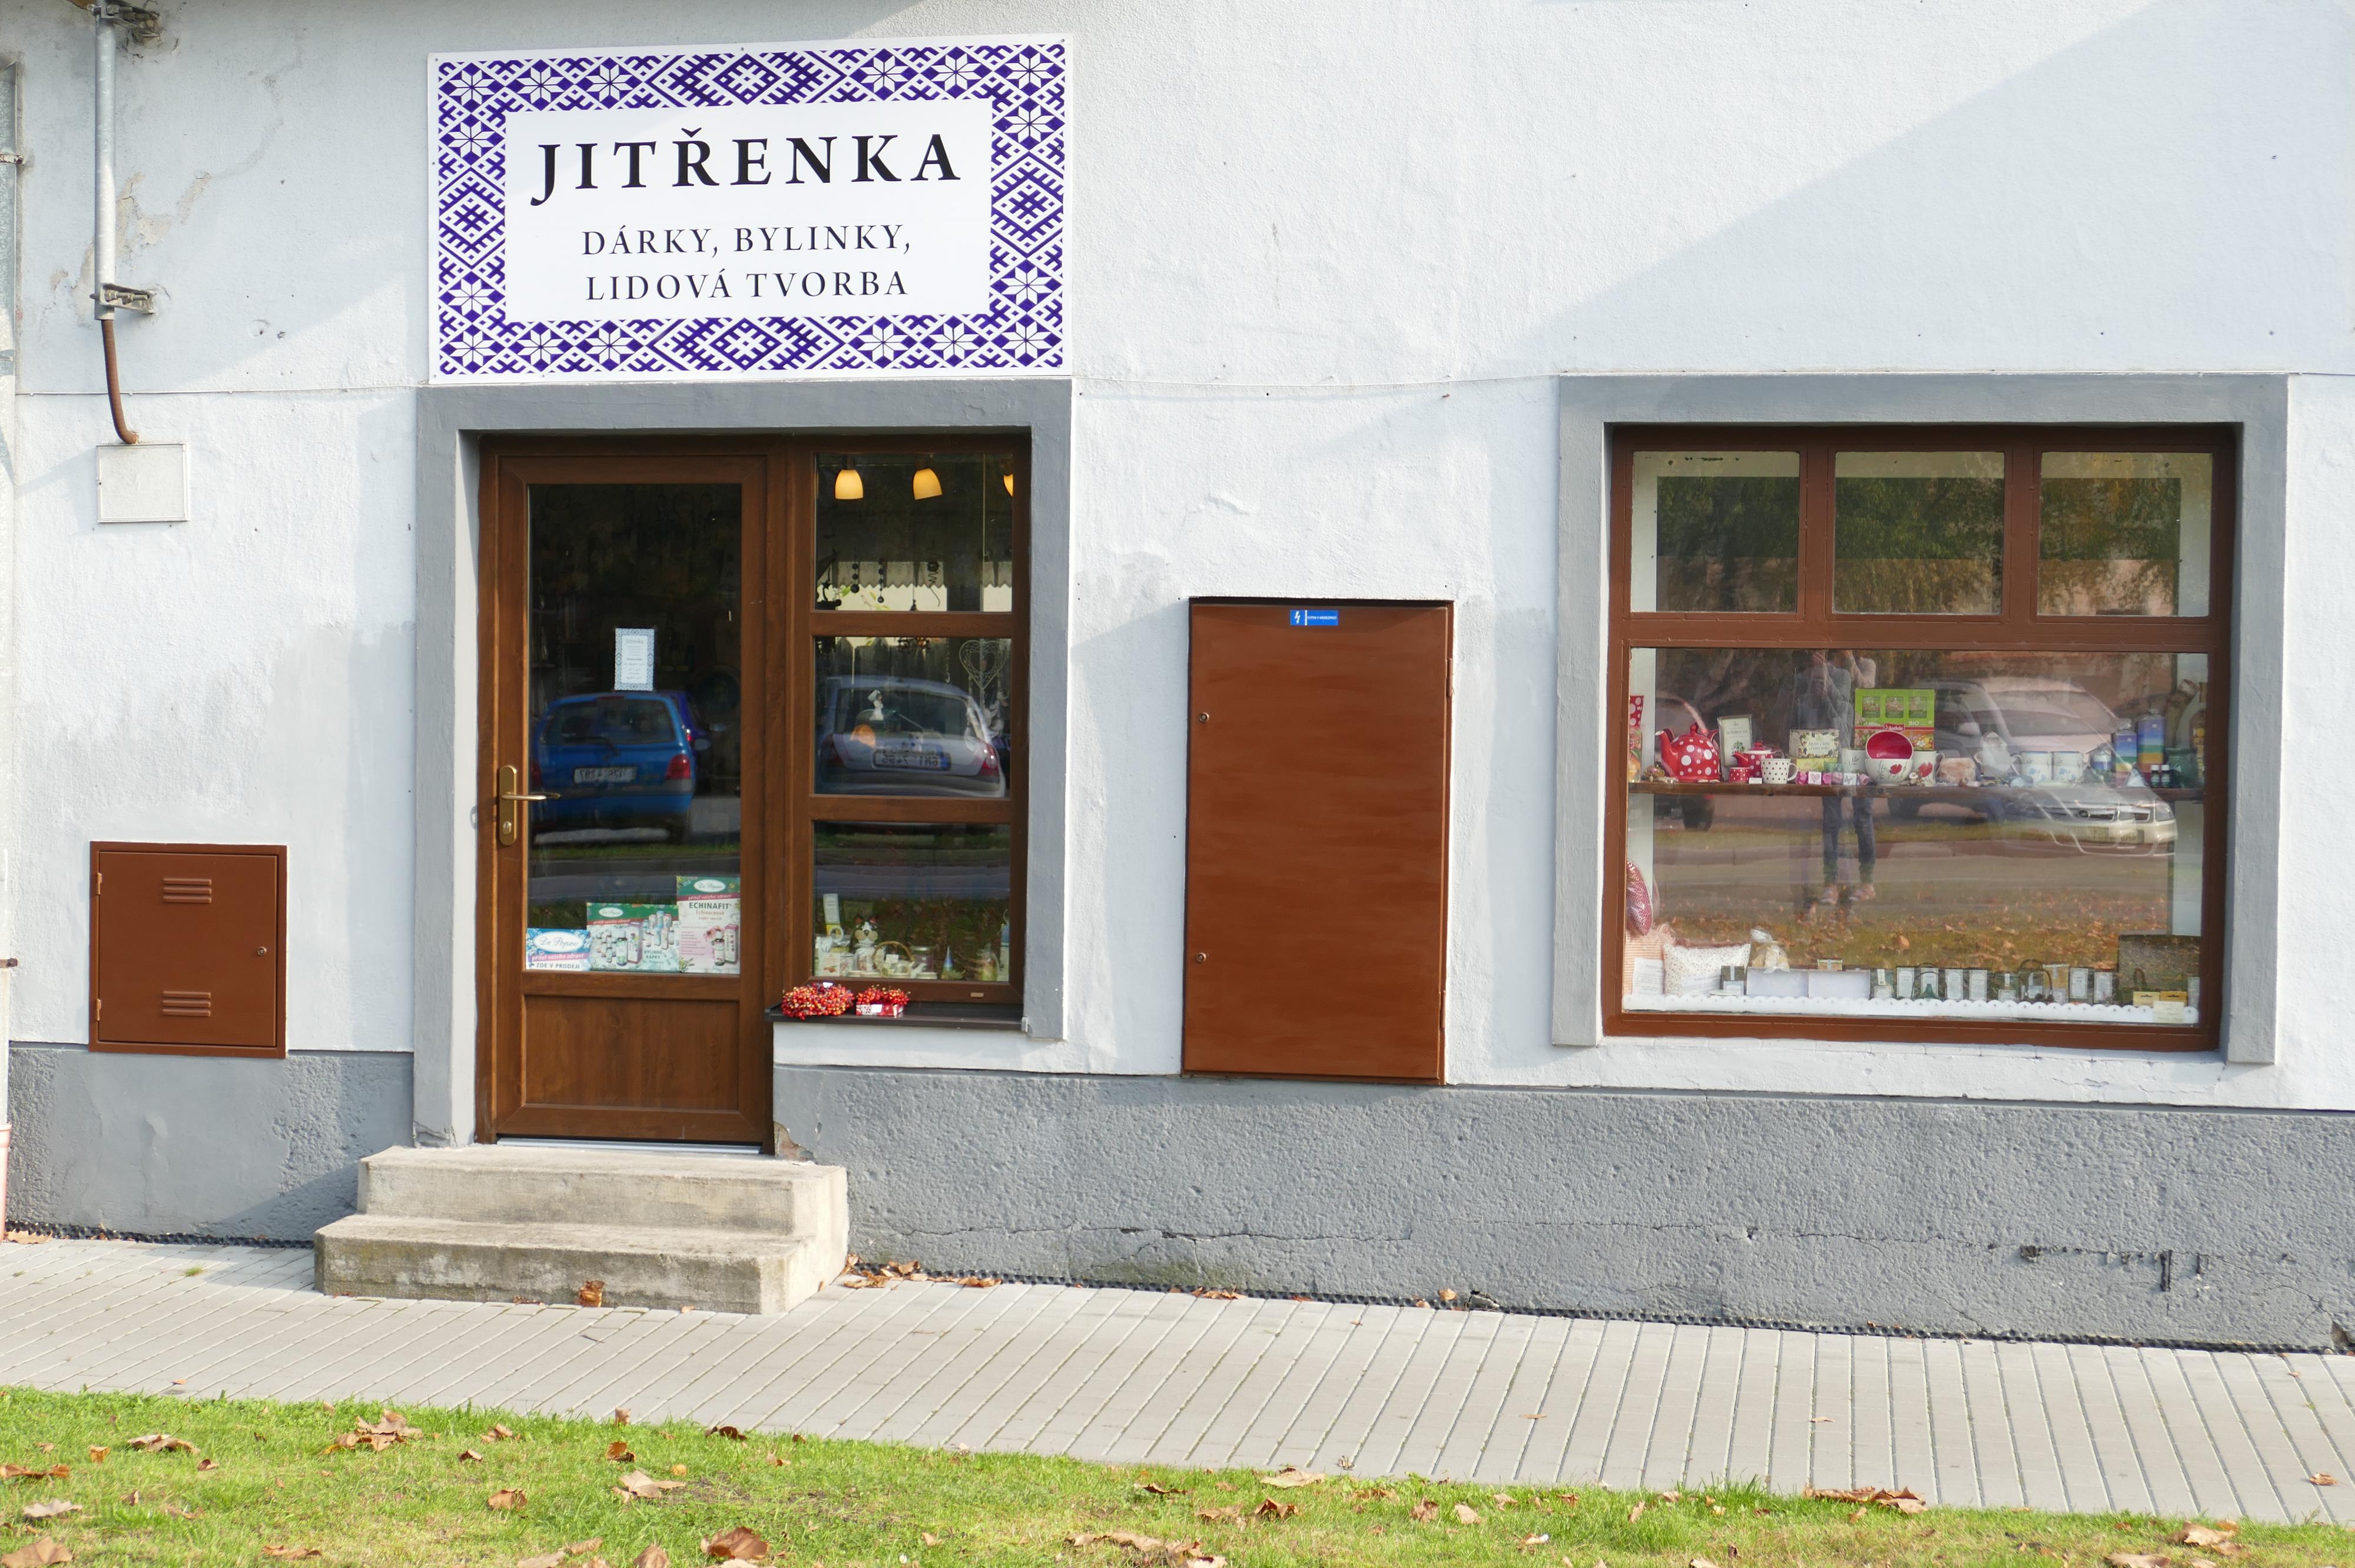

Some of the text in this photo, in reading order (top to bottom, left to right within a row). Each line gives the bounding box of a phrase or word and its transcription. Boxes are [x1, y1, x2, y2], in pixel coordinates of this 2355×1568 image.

[530, 128, 960, 205] JITŘENKA
[581, 224, 910, 258] DÁRKY, BYLINKY,
[586, 268, 908, 300] LIDOVÁ TVORBA
